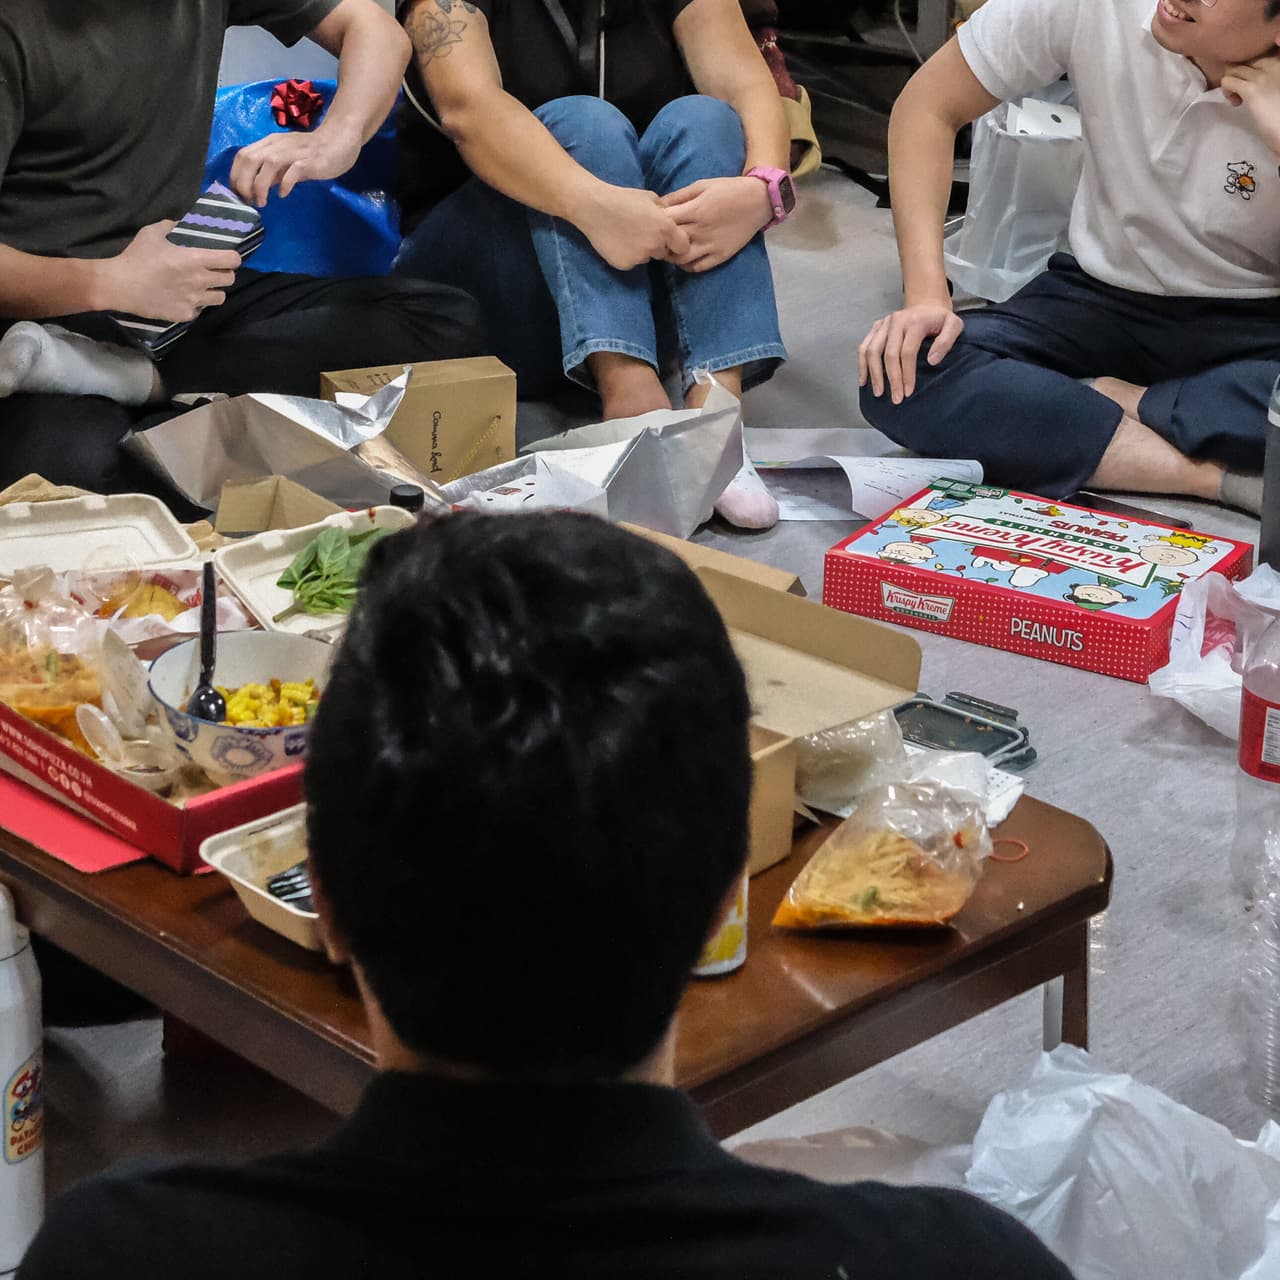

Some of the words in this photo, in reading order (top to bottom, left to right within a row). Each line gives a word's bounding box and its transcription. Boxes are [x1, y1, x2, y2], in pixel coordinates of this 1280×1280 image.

[939, 520, 1044, 553] Kreme
[994, 518, 1121, 551] DOUGHNUTS
[1049, 519, 1128, 543] PEANUTS
[1038, 535, 1145, 575] Krispy
[886, 589, 918, 609] Krispy
[917, 597, 949, 614] Kreme
[1010, 617, 1084, 652] PEANUTS
